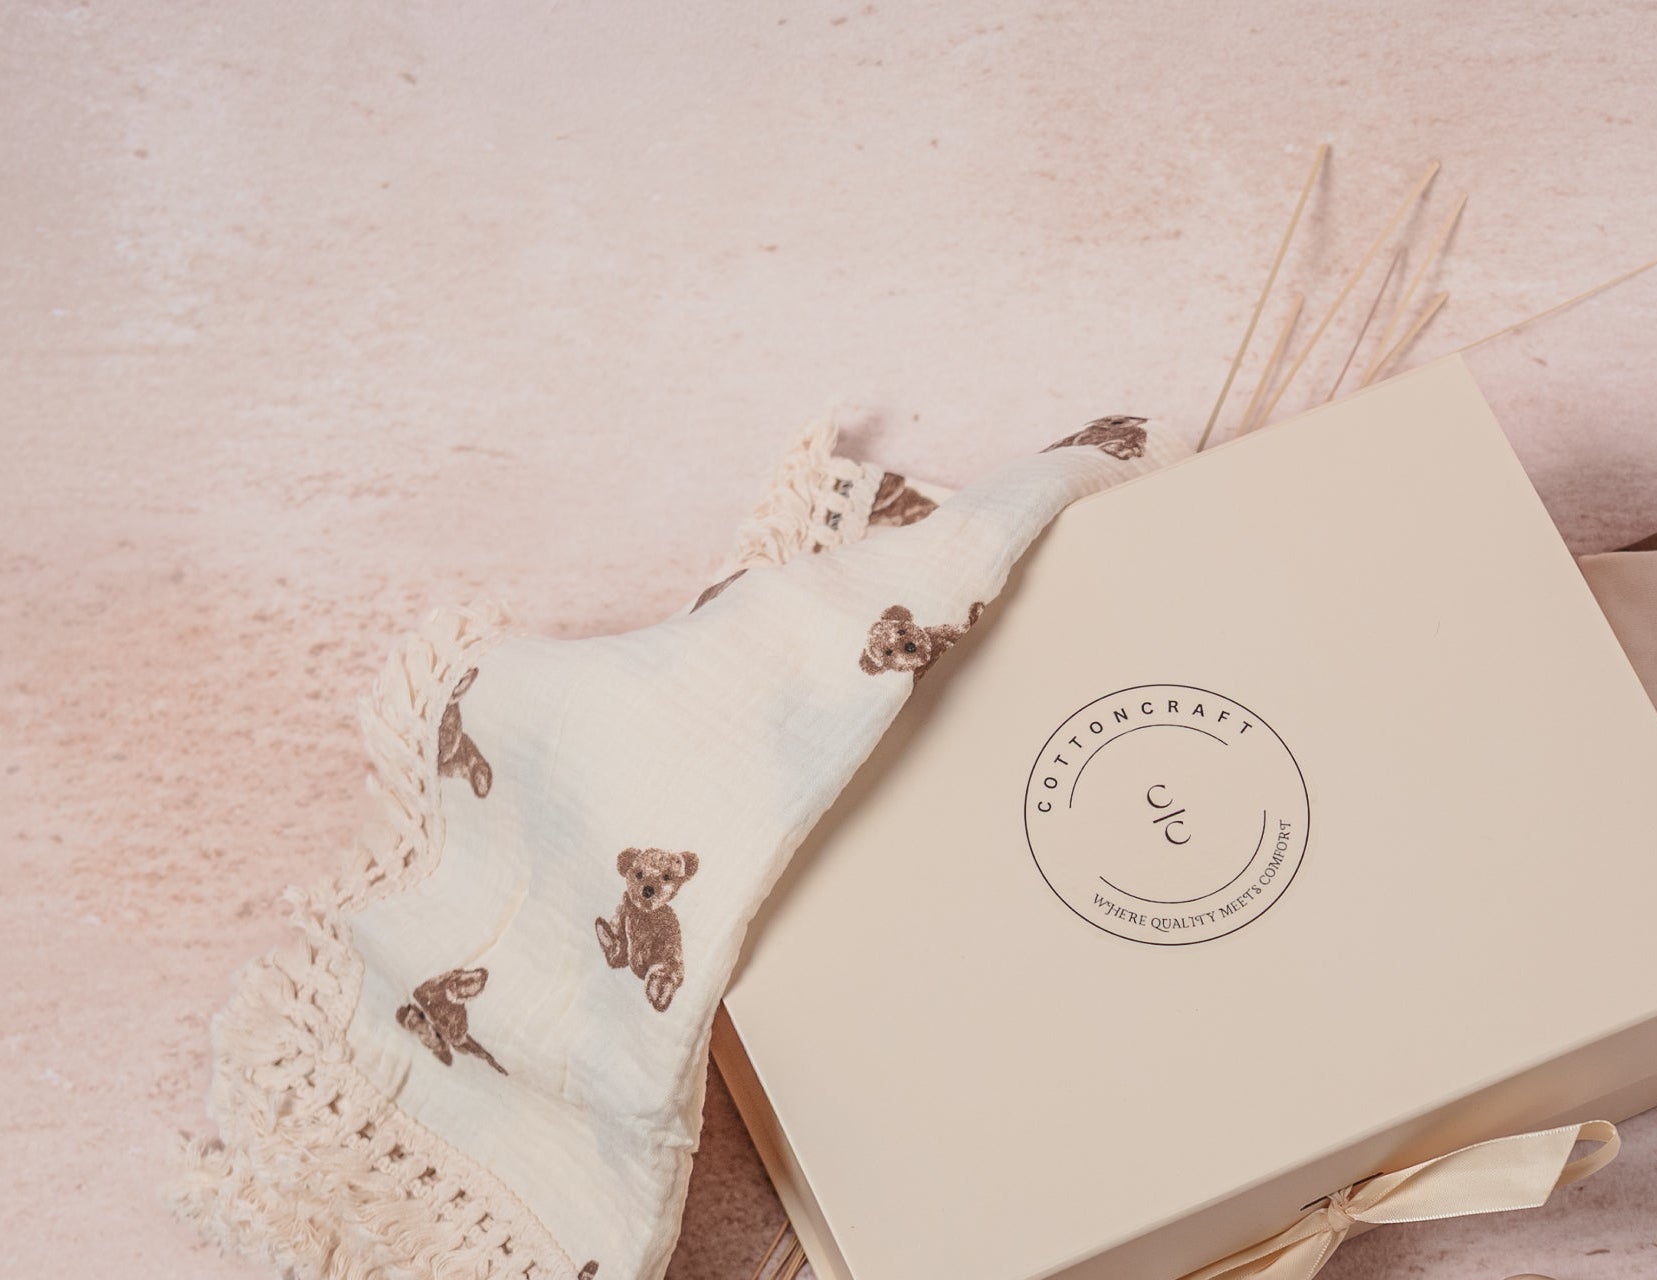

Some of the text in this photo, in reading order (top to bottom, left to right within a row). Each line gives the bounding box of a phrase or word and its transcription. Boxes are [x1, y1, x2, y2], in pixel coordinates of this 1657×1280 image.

[1037, 700, 1253, 813] COTTONCRAFT
[1093, 819, 1291, 932] WHERE QUALITY MEETS COMFORT
